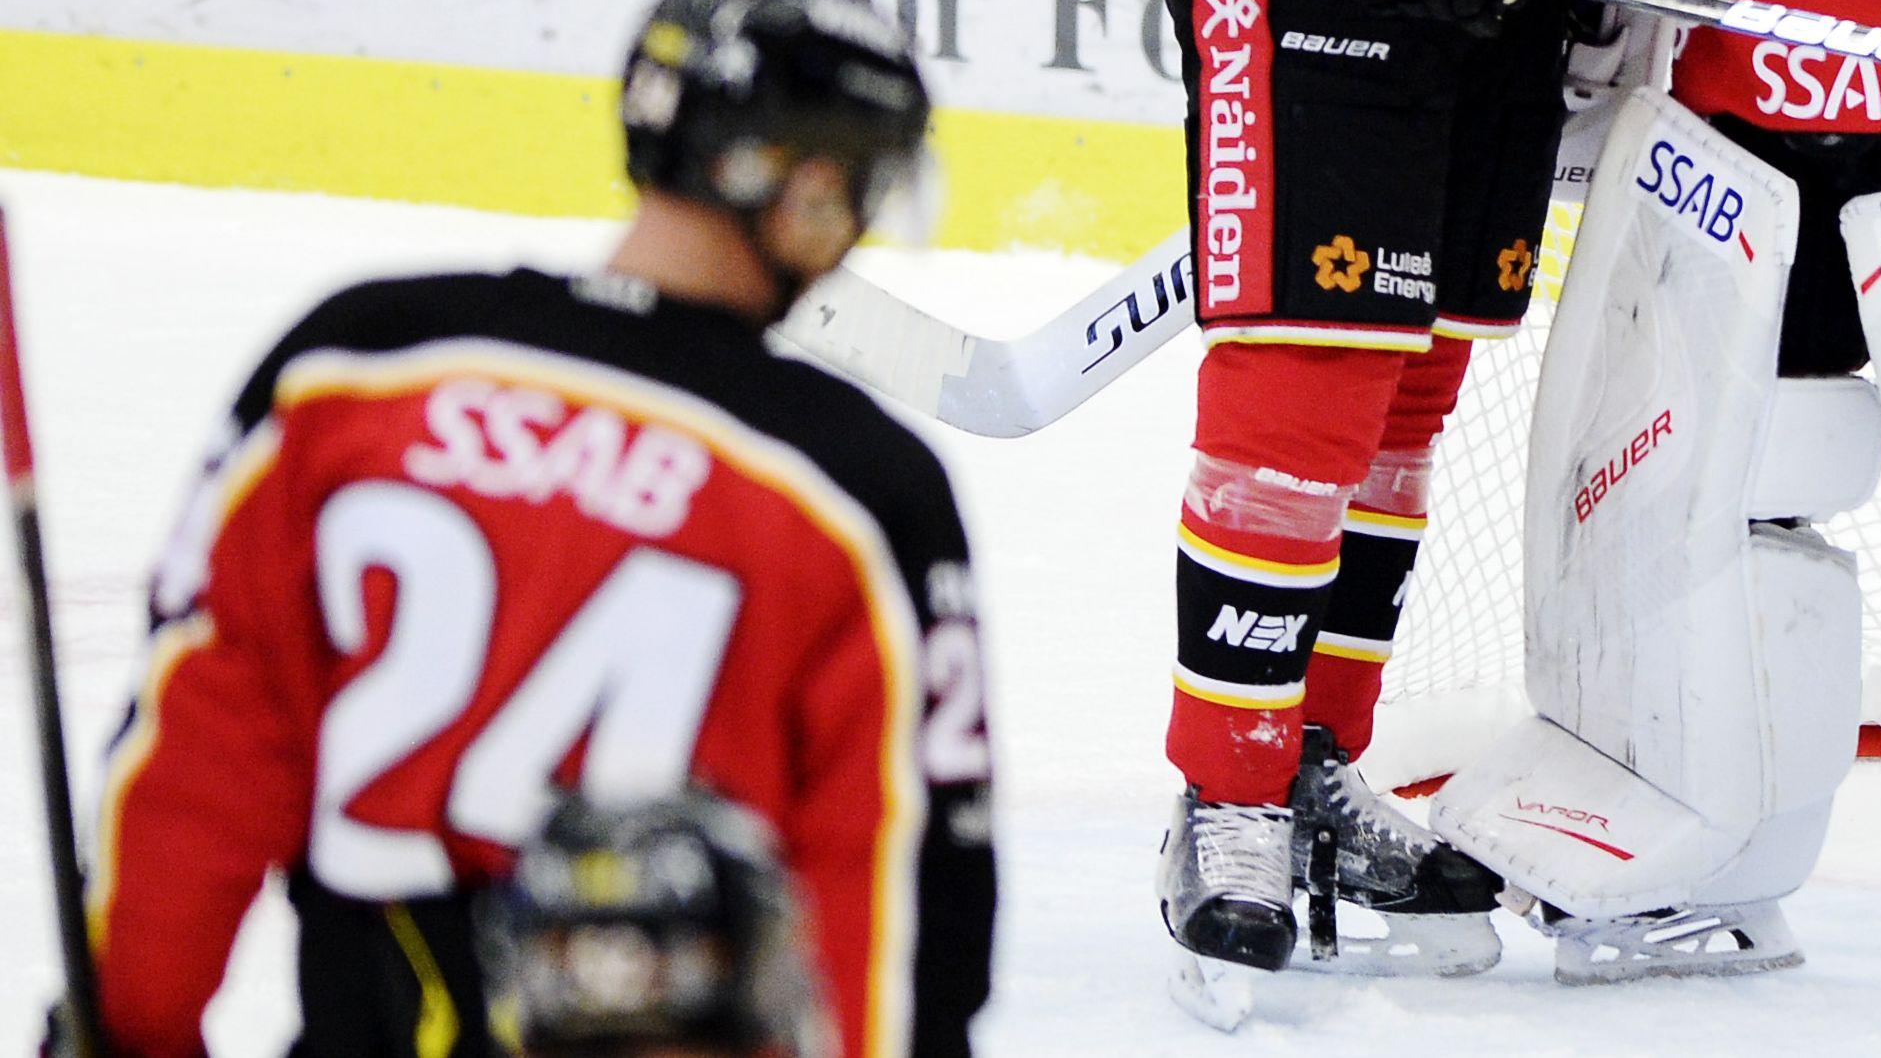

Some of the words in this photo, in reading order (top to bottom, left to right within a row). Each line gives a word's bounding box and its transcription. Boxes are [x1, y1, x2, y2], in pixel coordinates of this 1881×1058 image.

[1281, 31, 1391, 61] BAUER
[1636, 140, 1744, 243] SSAB
[404, 377, 711, 538] SSAB
[1573, 409, 1674, 524] BAUER
[1206, 604, 1308, 653] NEX
[308, 481, 744, 900] 24
